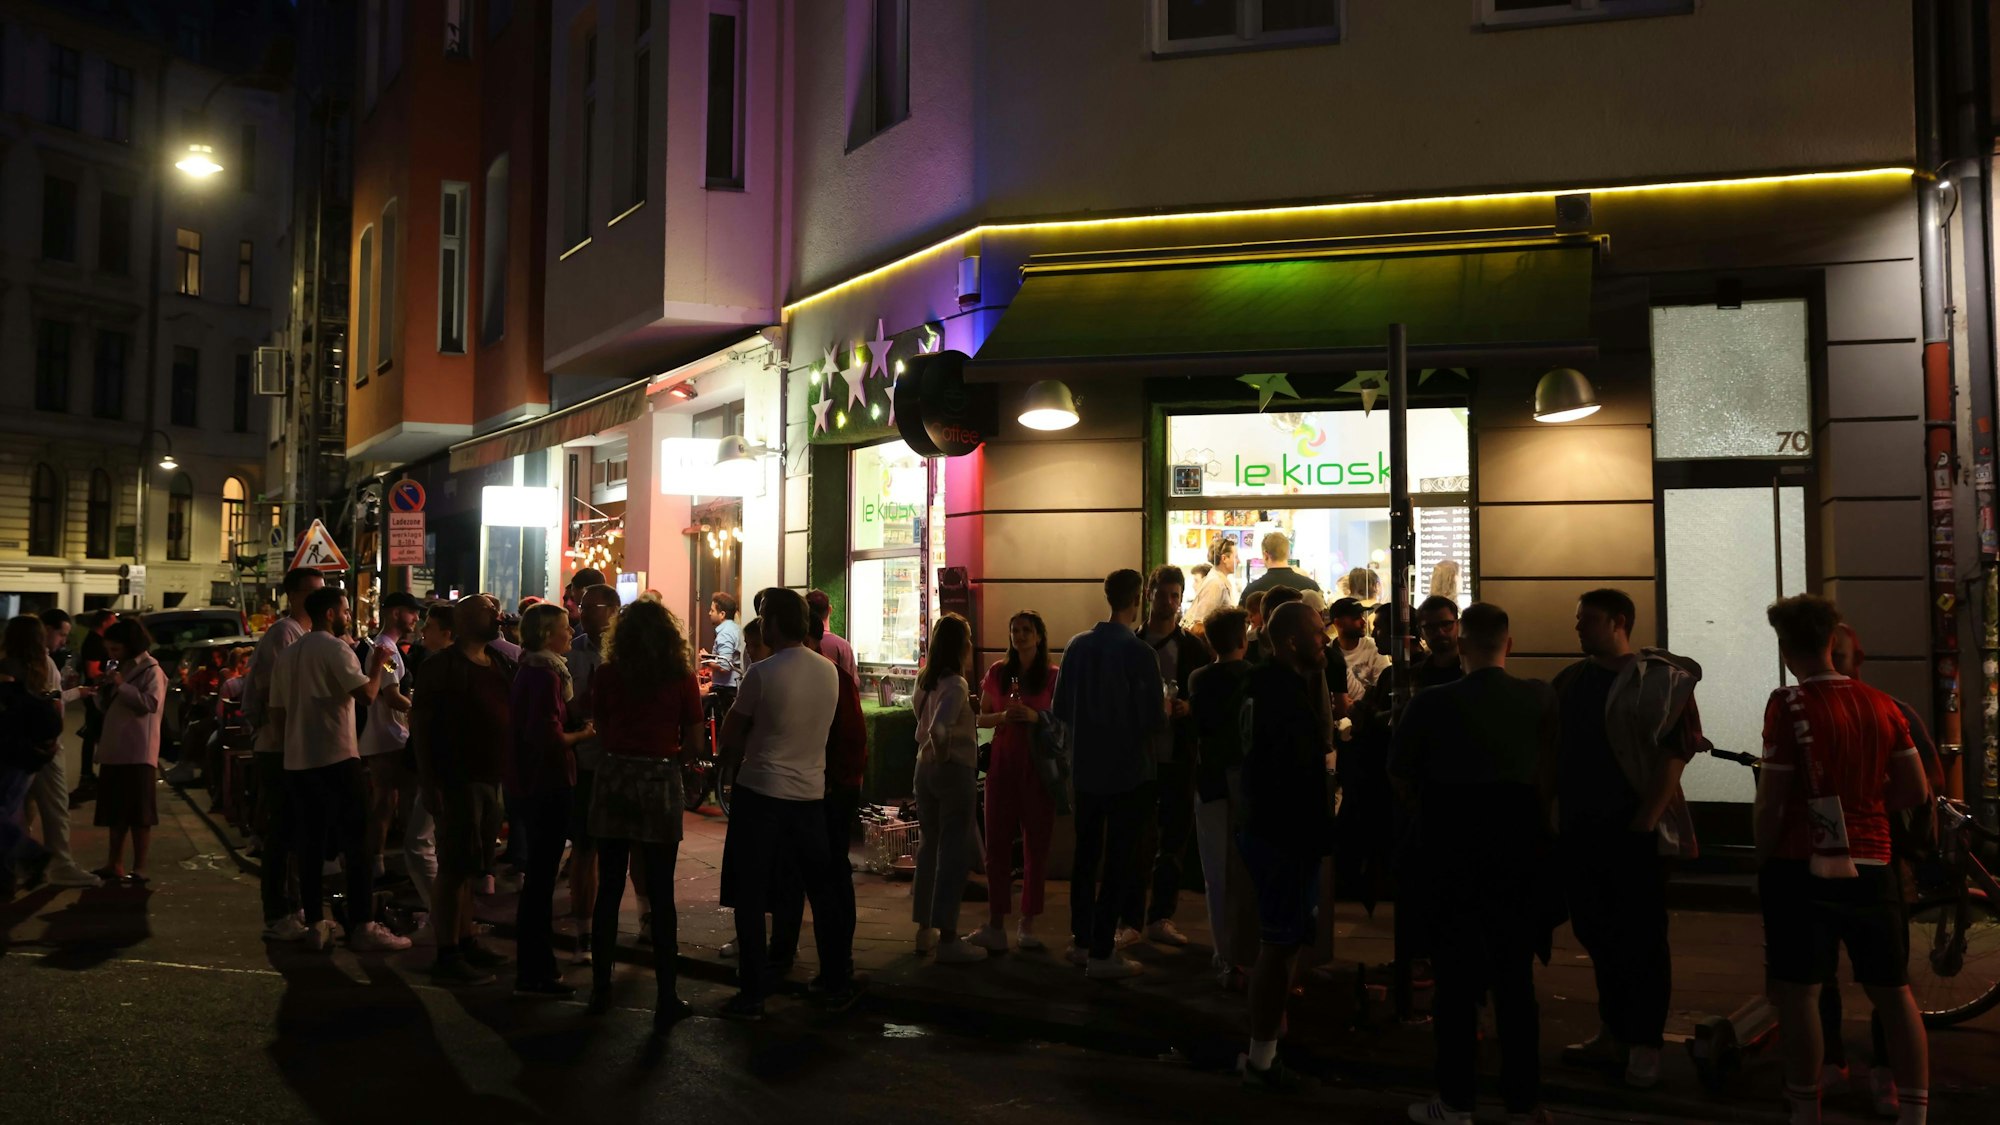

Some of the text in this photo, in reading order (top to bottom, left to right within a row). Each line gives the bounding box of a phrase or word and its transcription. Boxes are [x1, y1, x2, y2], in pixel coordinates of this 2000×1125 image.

[930, 422, 979, 445] Coffee
[1776, 431, 1810, 453] 70
[1235, 451, 1391, 487] le kiosk
[862, 496, 875, 523] le
[392, 518, 421, 526] Ladezone
